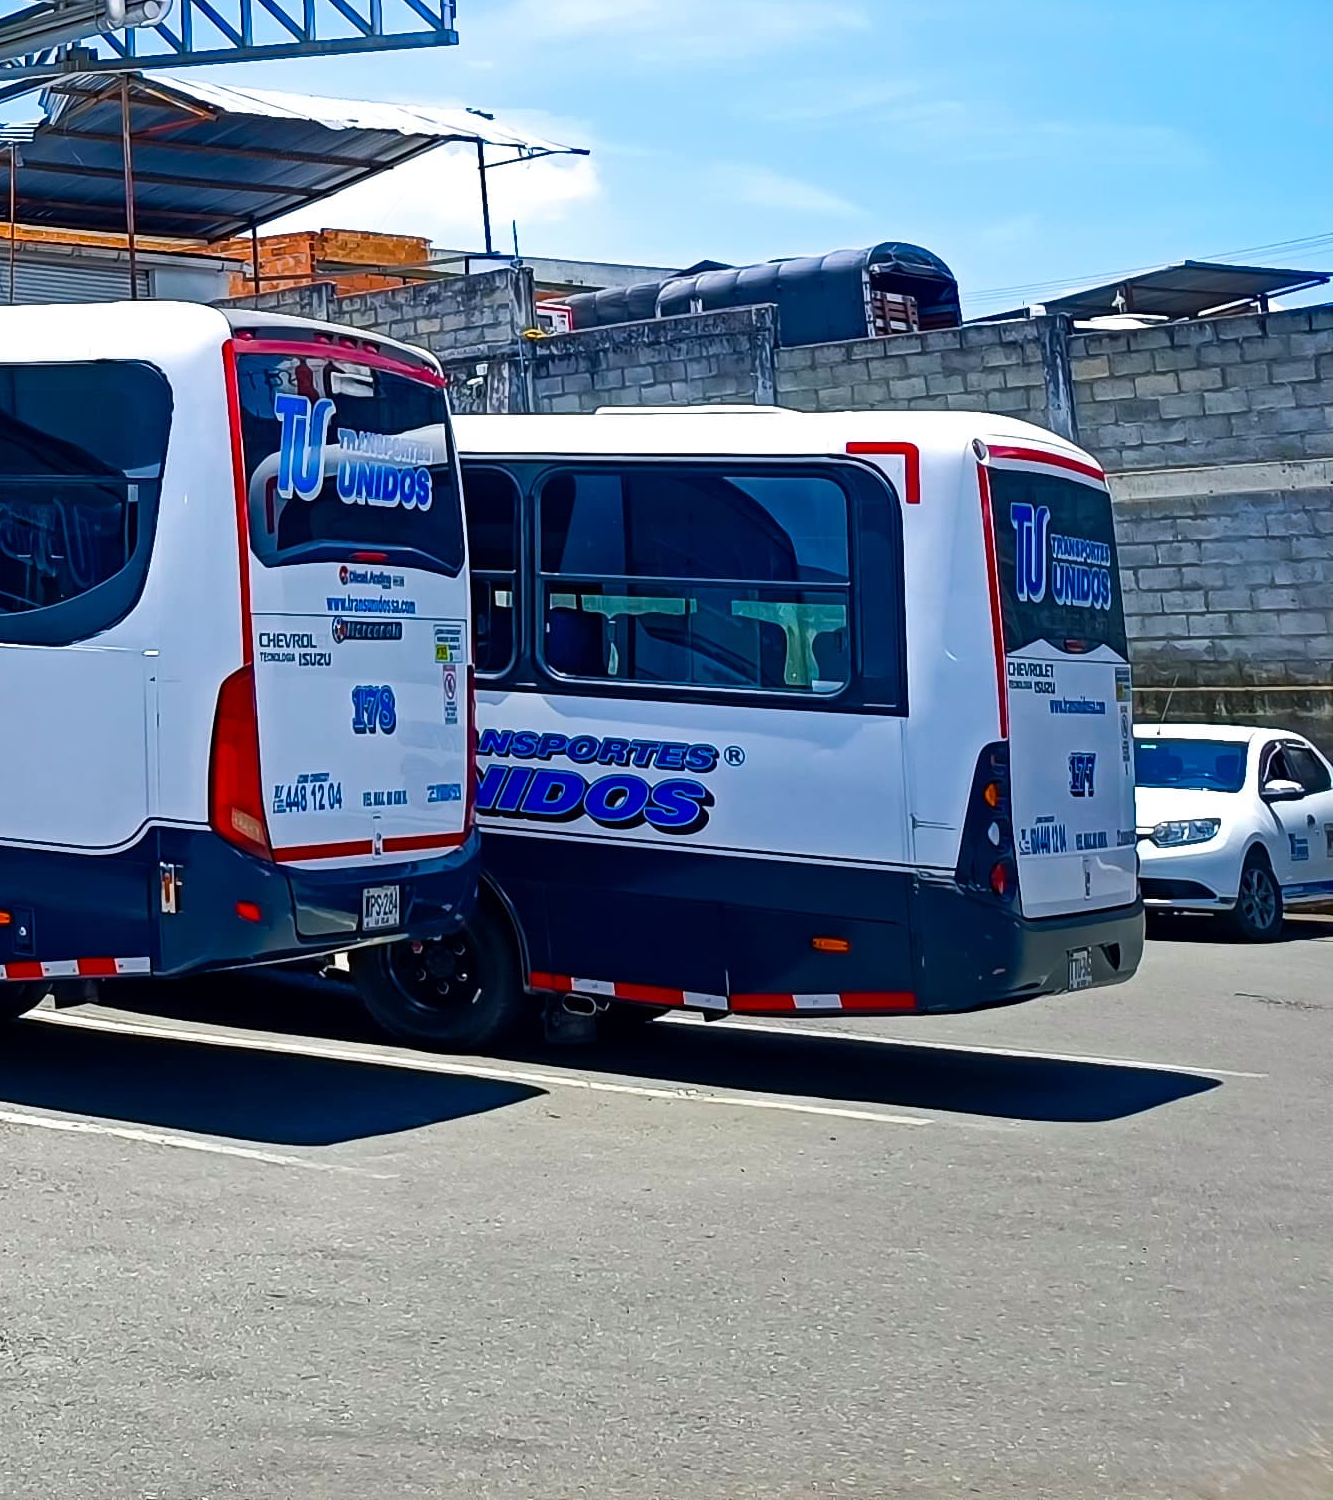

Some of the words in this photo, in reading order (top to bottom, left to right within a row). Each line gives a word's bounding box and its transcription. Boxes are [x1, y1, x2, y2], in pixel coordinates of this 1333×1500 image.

[275, 393, 336, 501] TU
[337, 460, 432, 511] UNIDOS
[1010, 502, 1050, 603] TU
[1050, 534, 1110, 567] TRANSPORTES
[1052, 561, 1111, 611] UNIDOS
[298, 652, 331, 667] ISUZU
[352, 685, 396, 735] 178
[476, 729, 719, 773] NSPORTES
